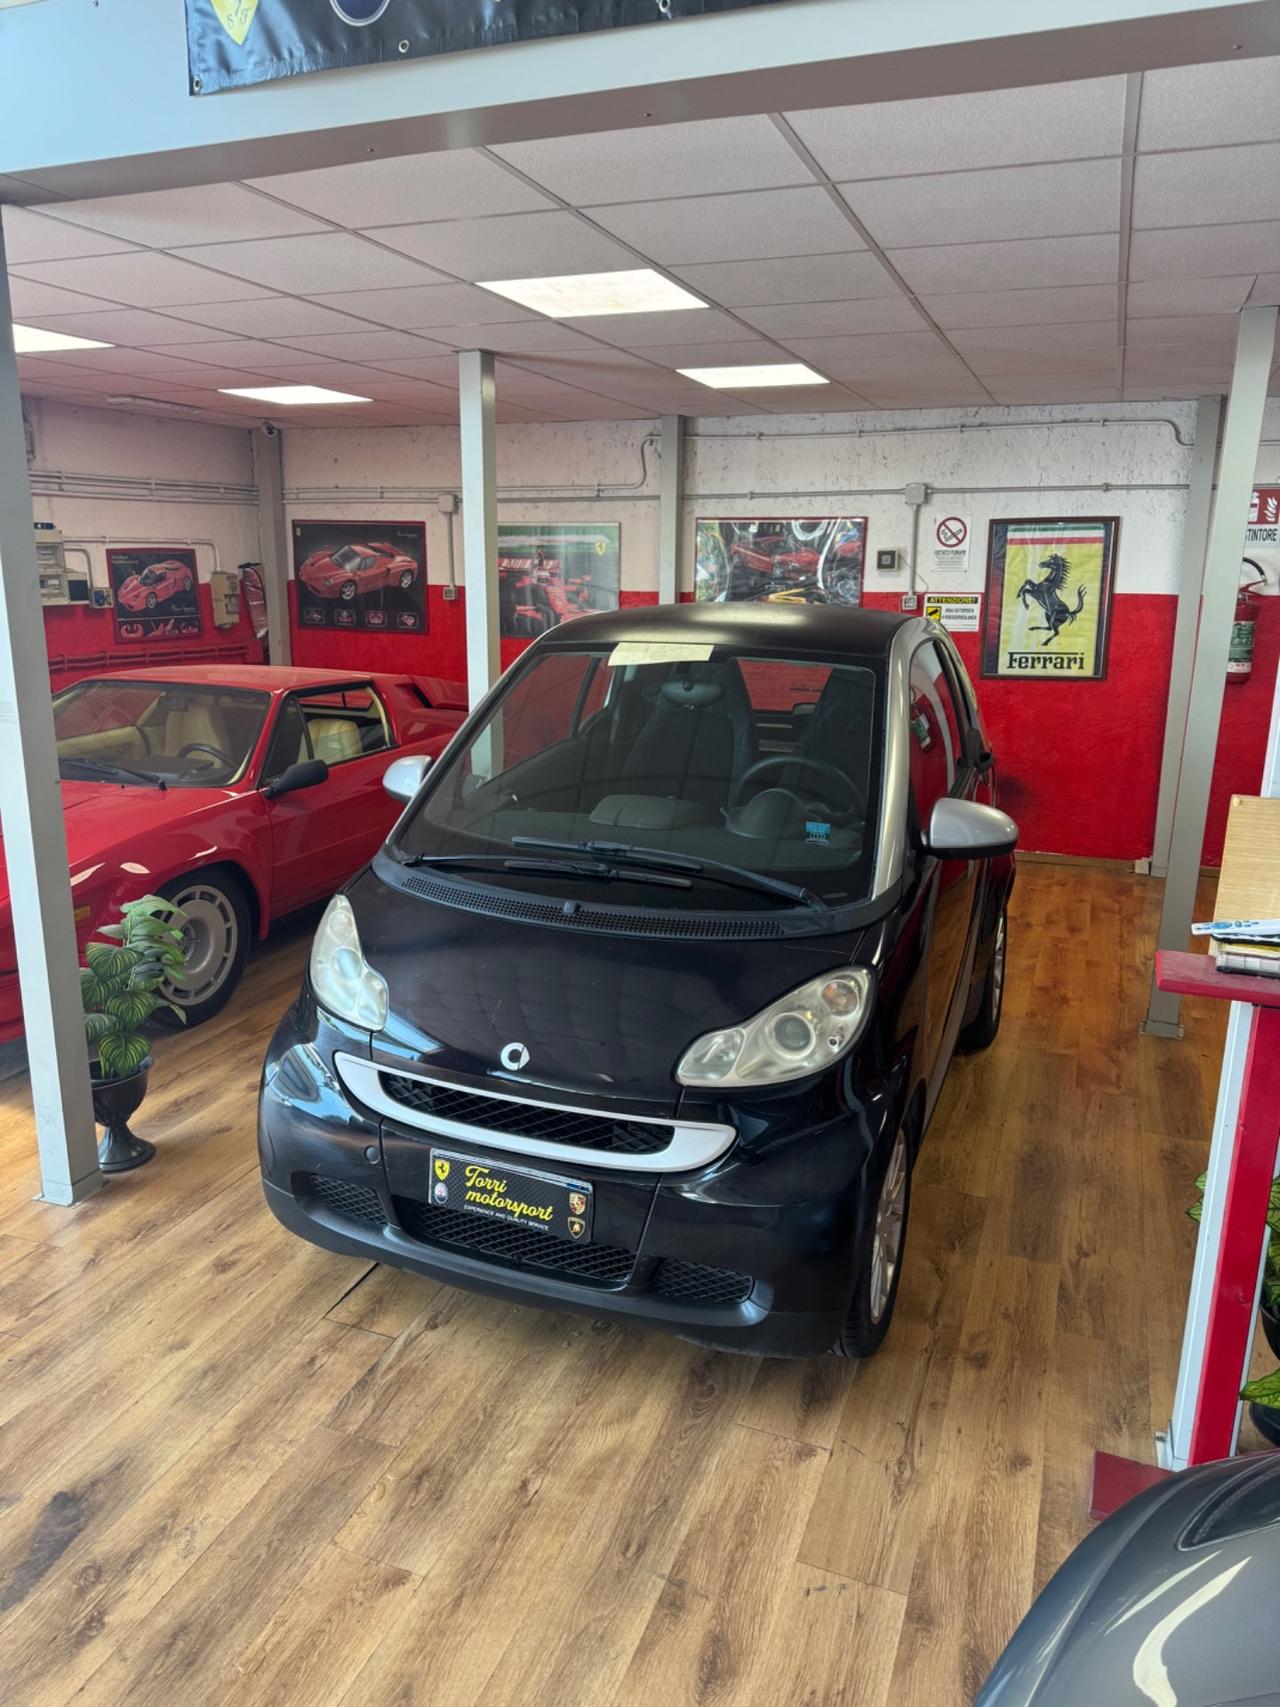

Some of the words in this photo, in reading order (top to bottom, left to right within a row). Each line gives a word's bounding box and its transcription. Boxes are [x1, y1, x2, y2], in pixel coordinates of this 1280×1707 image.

[1007, 652, 1085, 670] Ferrari
[465, 1165, 507, 1192] Torri
[465, 1190, 553, 1220] motorsport
